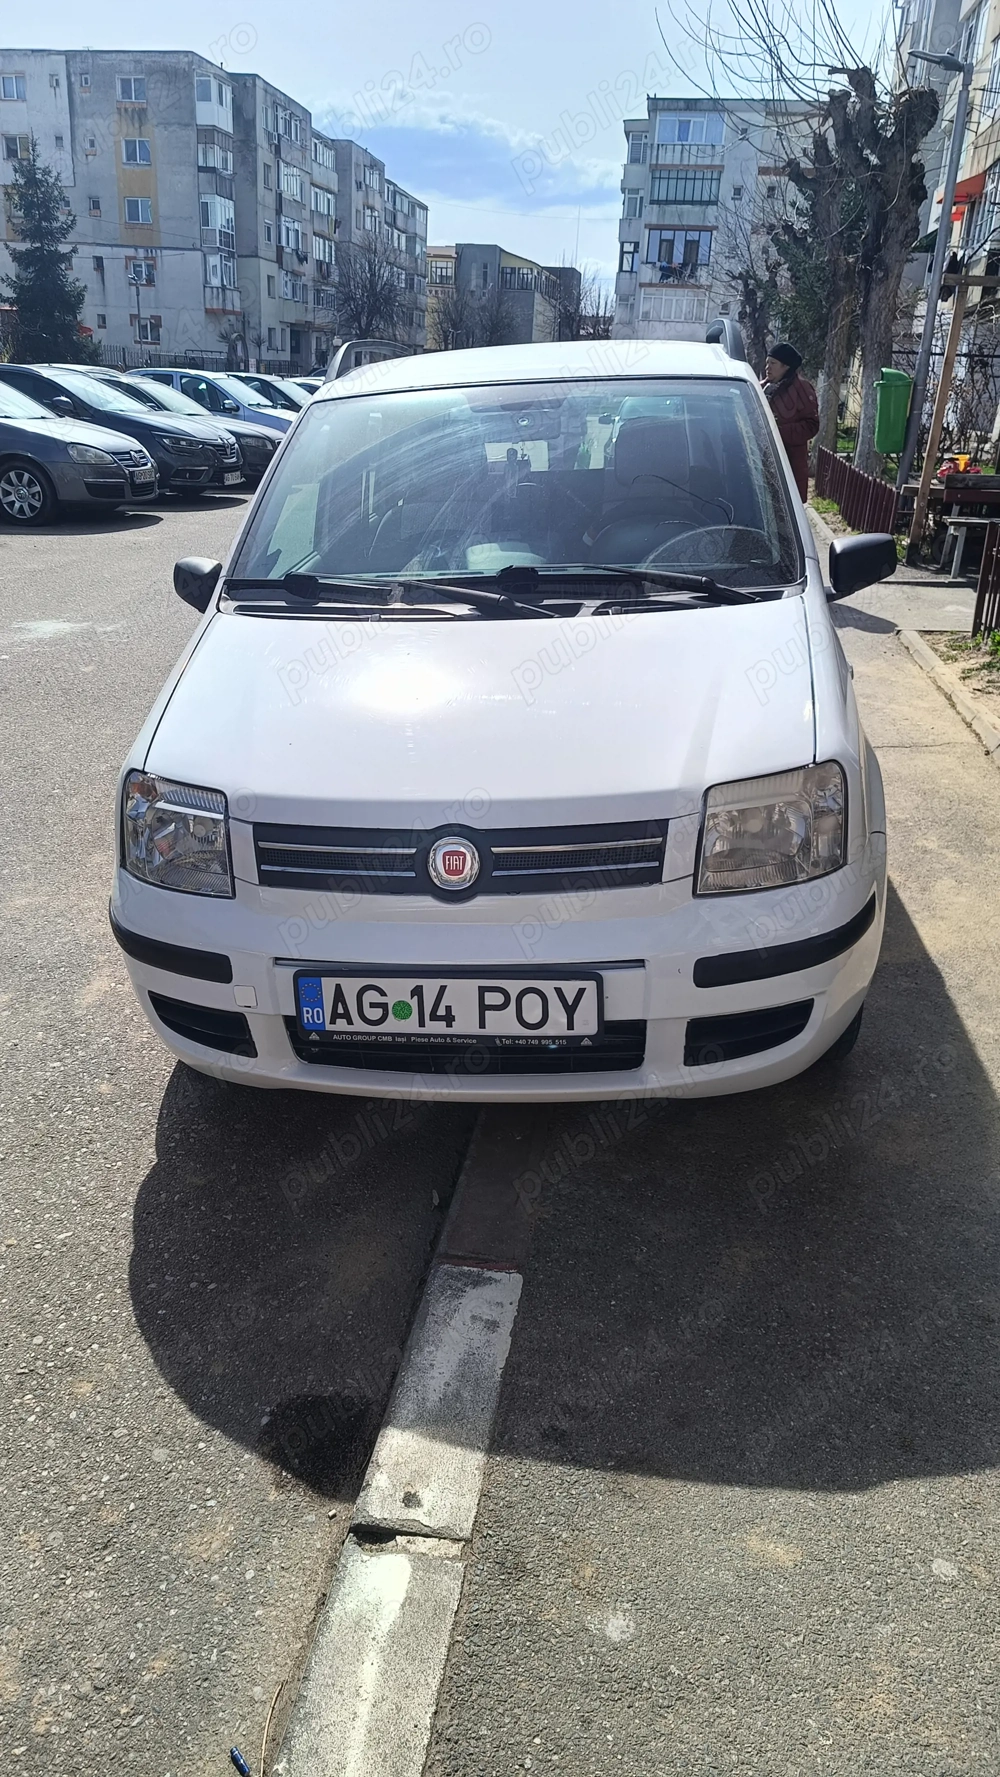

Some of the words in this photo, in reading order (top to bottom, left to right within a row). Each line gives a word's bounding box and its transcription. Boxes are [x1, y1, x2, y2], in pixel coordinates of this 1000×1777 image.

[445, 855, 464, 871] FIAT
[302, 1006, 323, 1024] RO
[328, 983, 390, 1027] AG
[409, 984, 456, 1028] 14
[477, 985, 587, 1031] POY
